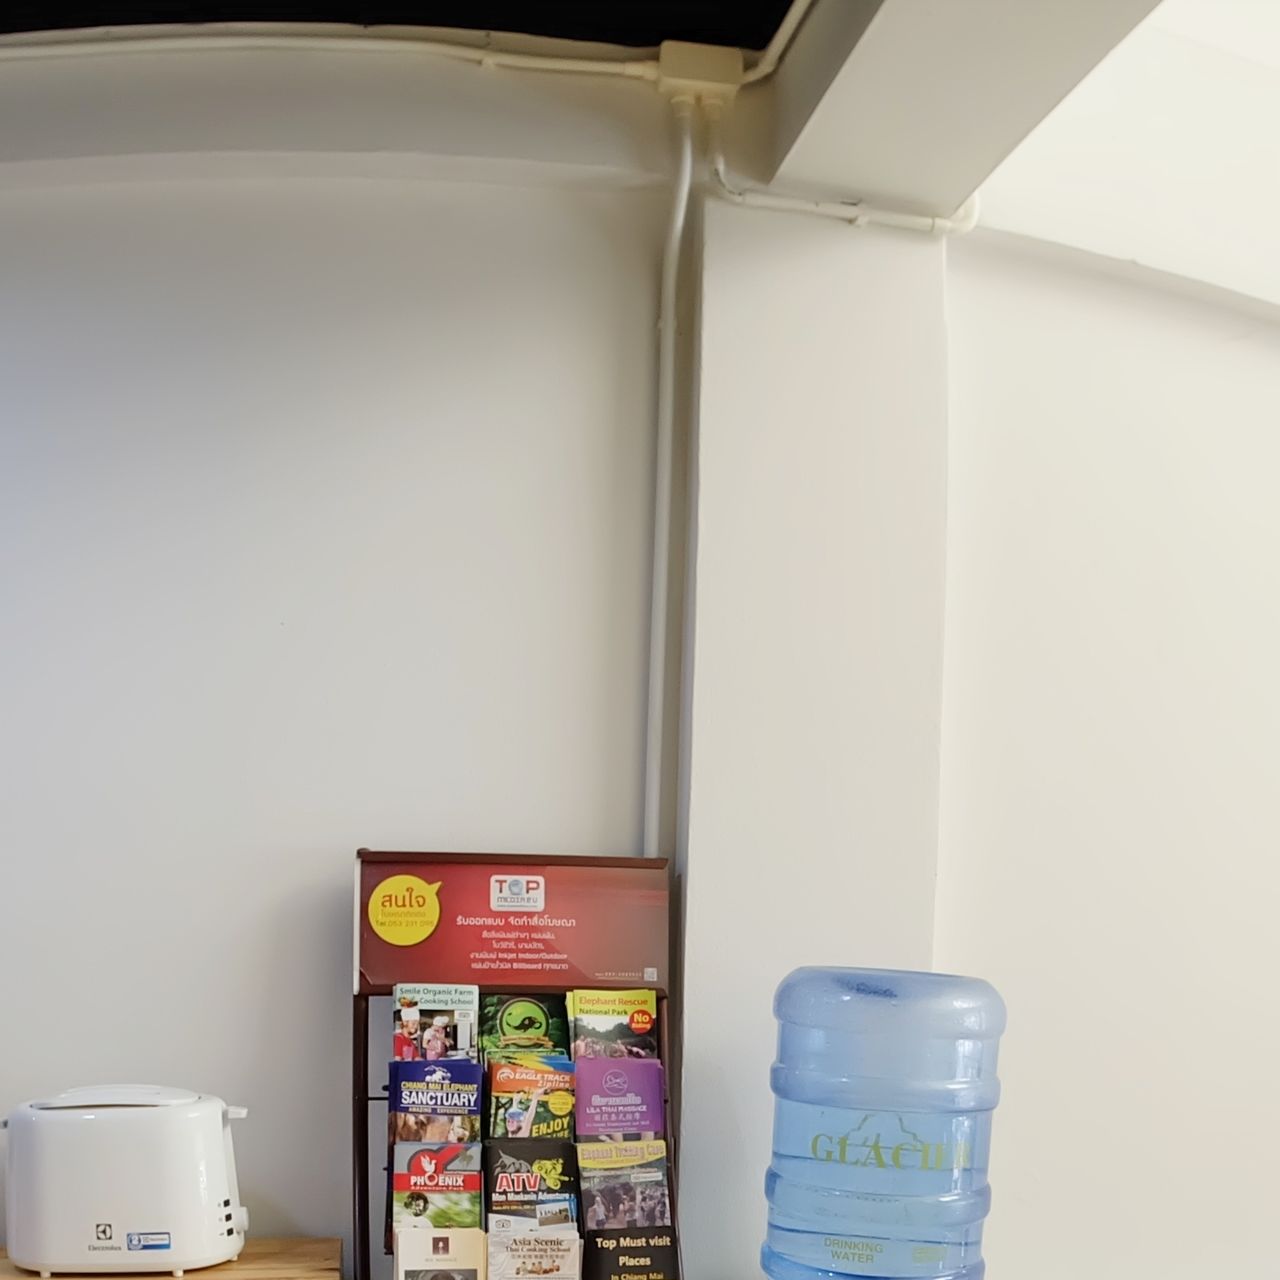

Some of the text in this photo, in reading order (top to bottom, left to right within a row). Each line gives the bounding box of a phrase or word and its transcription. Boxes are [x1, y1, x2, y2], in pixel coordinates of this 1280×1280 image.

[495, 879, 539, 894] TOP
[381, 888, 426, 909] สนใจ
[423, 988, 453, 998] Organic
[419, 999, 449, 1008] Cooking
[580, 996, 649, 1008] Elephant Rescue
[580, 1008, 628, 1016] National Park
[634, 1013, 649, 1023] No
[516, 1073, 541, 1081] EAGLE
[401, 1081, 478, 1093] CHIANG MAI ELEPHANT
[401, 1091, 477, 1107] SANCTUARY
[532, 1117, 569, 1136] ENJOY
[410, 1173, 465, 1187] PHOENIX
[496, 1172, 540, 1192] ATV
[88, 1244, 122, 1252] Electrolux
[511, 1237, 565, 1247] Asia Scenic
[596, 1235, 672, 1250] Top Must visit
[823, 1237, 884, 1254] DRINKING
[505, 1246, 572, 1255] Thai Cooking School
[831, 1249, 875, 1264] WATER
[619, 1255, 652, 1267] Places
[649, 1272, 665, 1280] Mai
